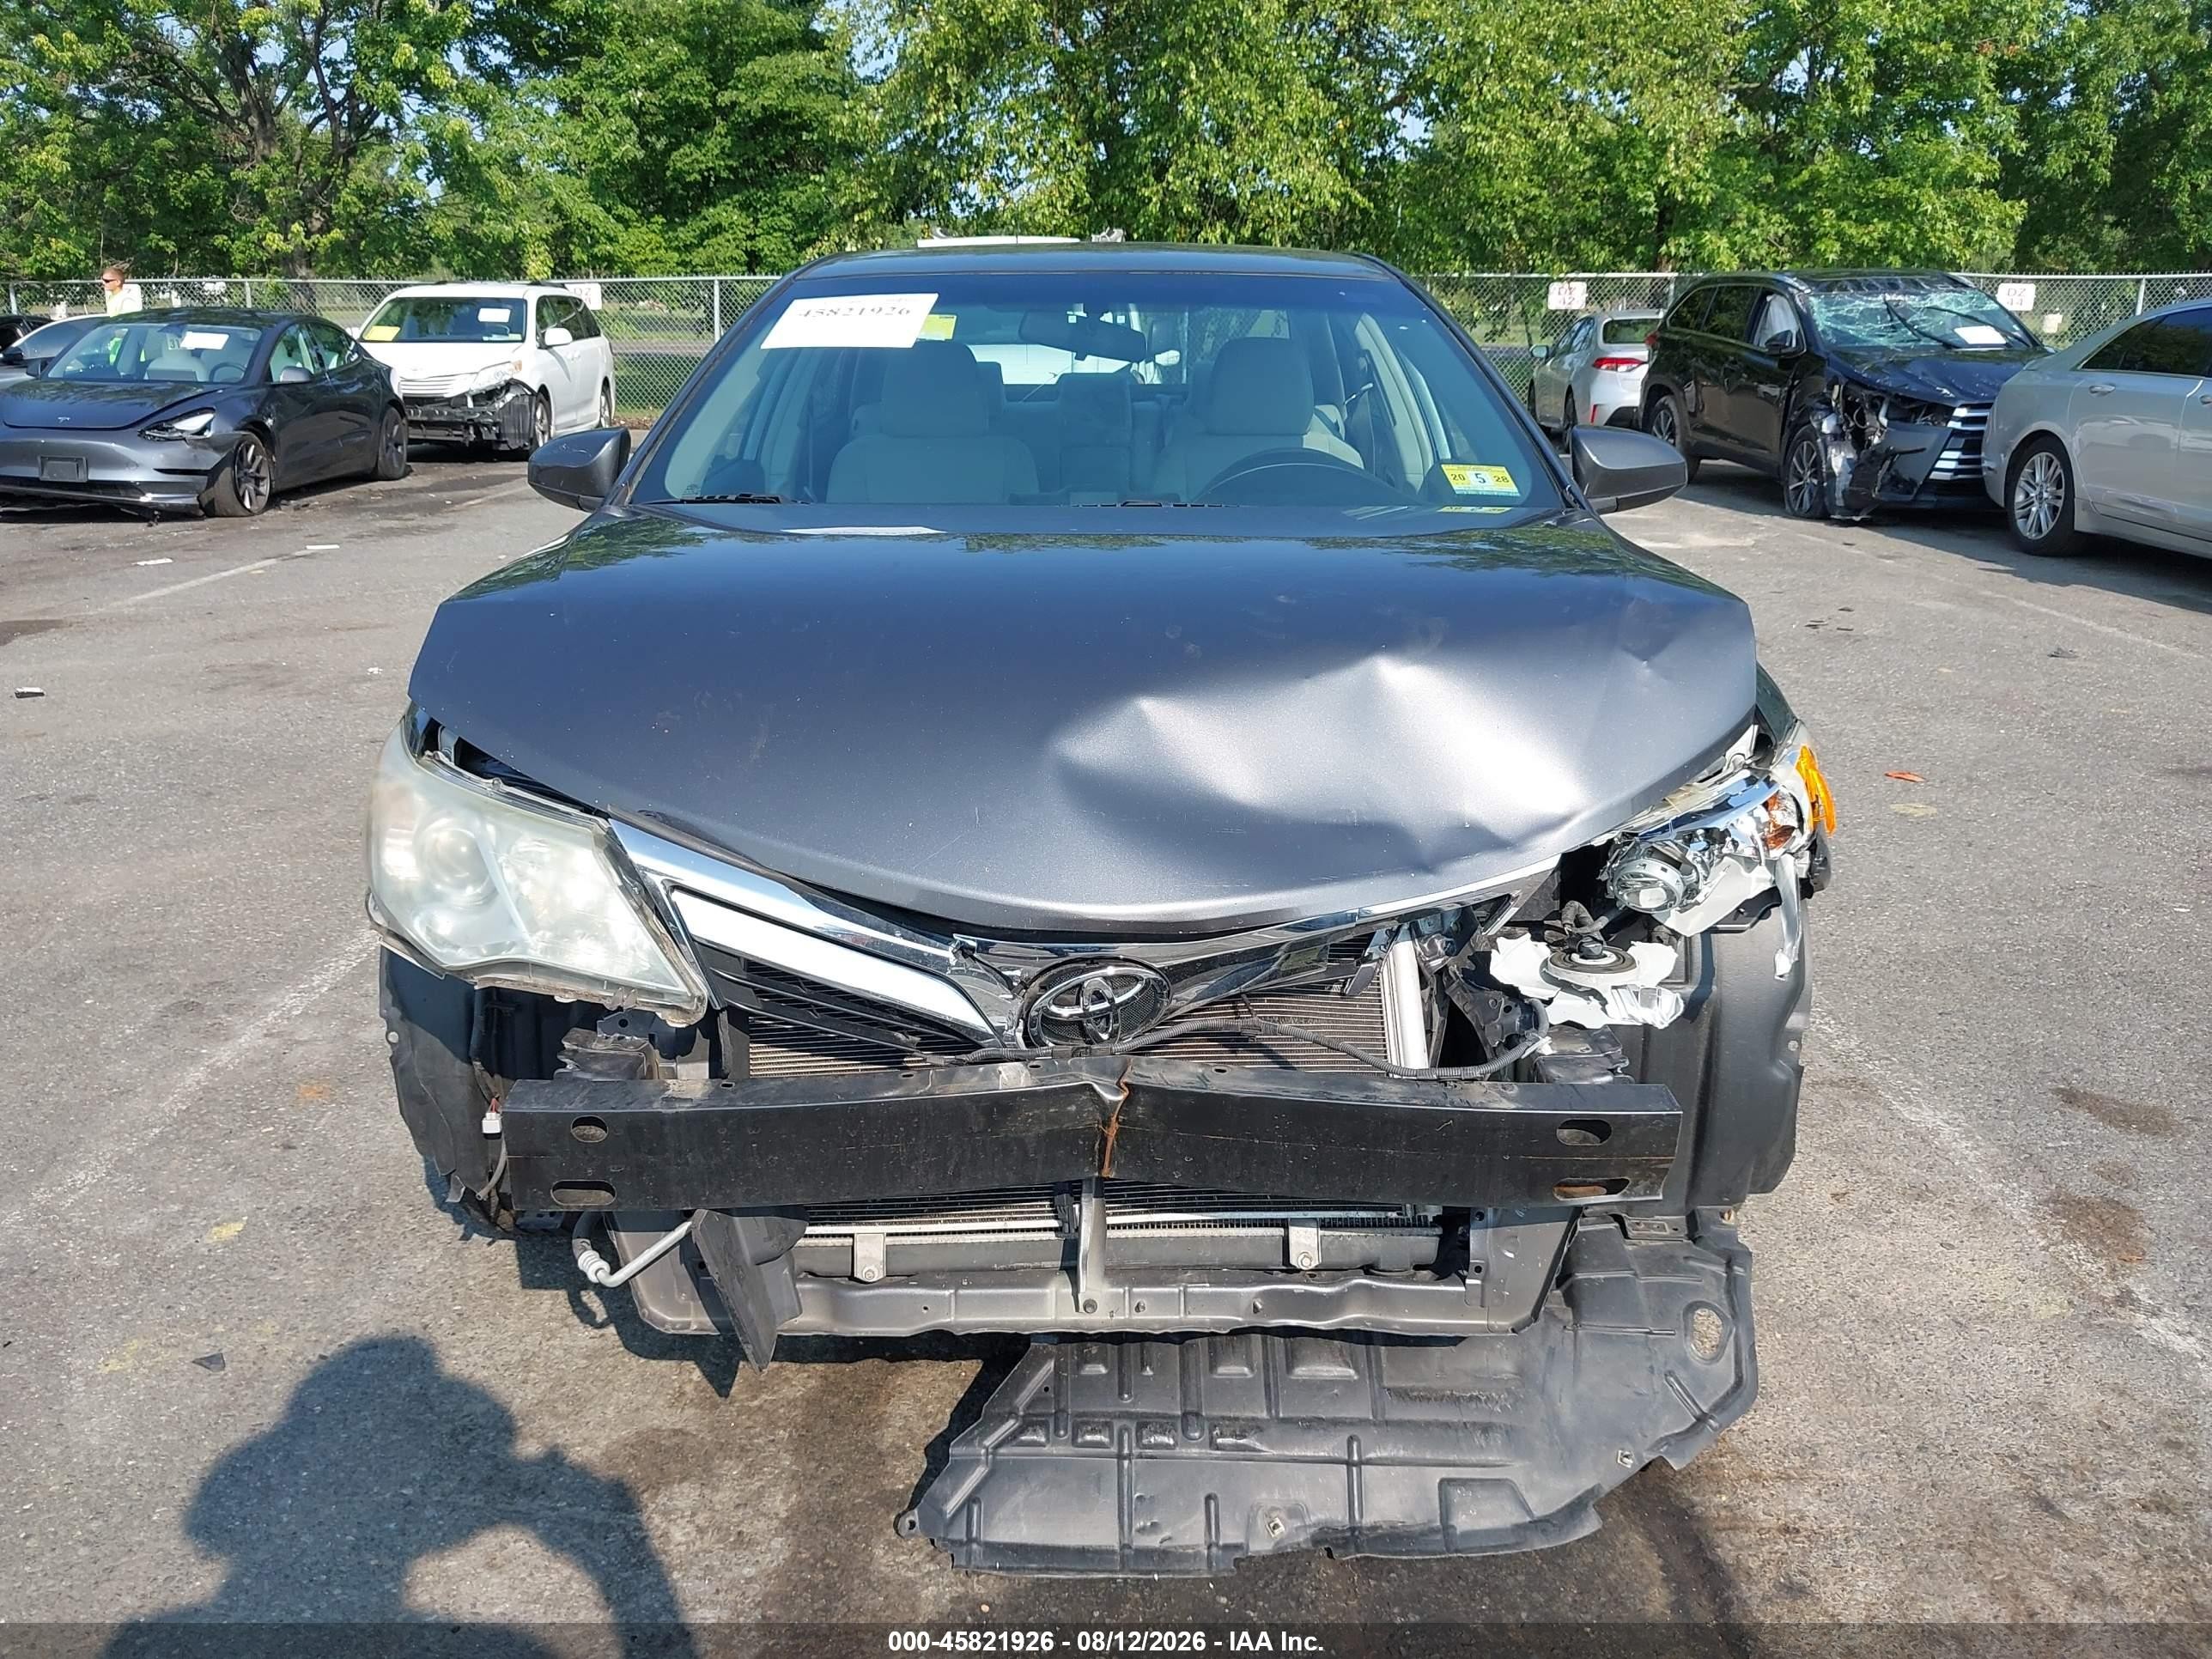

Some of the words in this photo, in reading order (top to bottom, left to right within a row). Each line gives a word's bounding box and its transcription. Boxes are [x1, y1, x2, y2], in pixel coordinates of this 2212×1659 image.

[2007, 288, 2027, 296] DZ
[1450, 473, 1466, 482] 20
[1474, 472, 1486, 484] 5
[1493, 475, 1510, 483] 28
